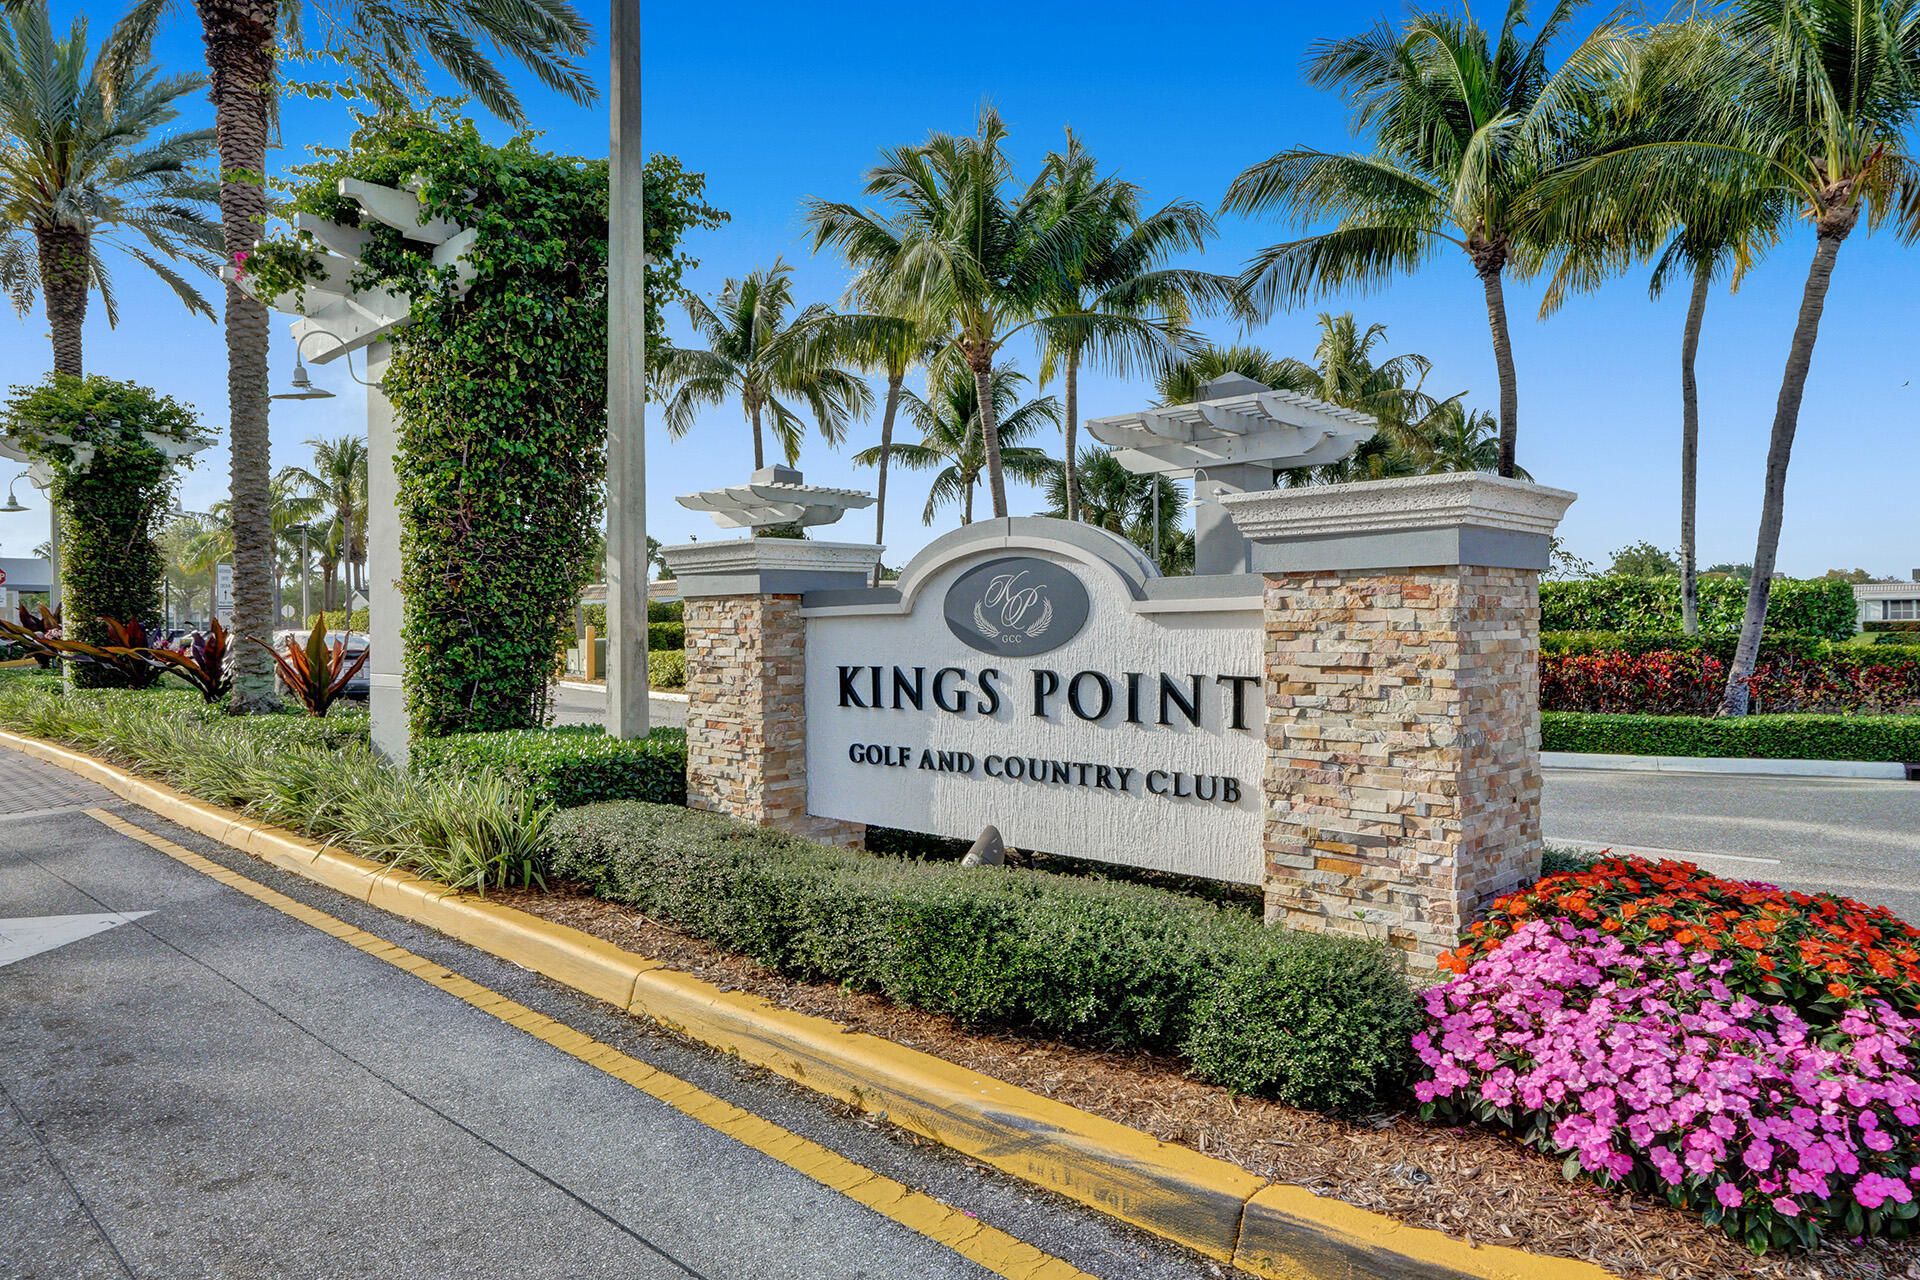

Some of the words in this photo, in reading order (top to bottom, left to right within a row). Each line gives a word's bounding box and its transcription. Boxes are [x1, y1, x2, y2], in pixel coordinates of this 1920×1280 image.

[1001, 635, 1022, 643] GCC
[836, 666, 1000, 716] KINGS
[1031, 669, 1262, 730] POINT
[849, 744, 911, 767] GOLF
[919, 750, 975, 773] AND
[984, 756, 1134, 792] COUNTRY
[1146, 770, 1242, 804] CLUB
